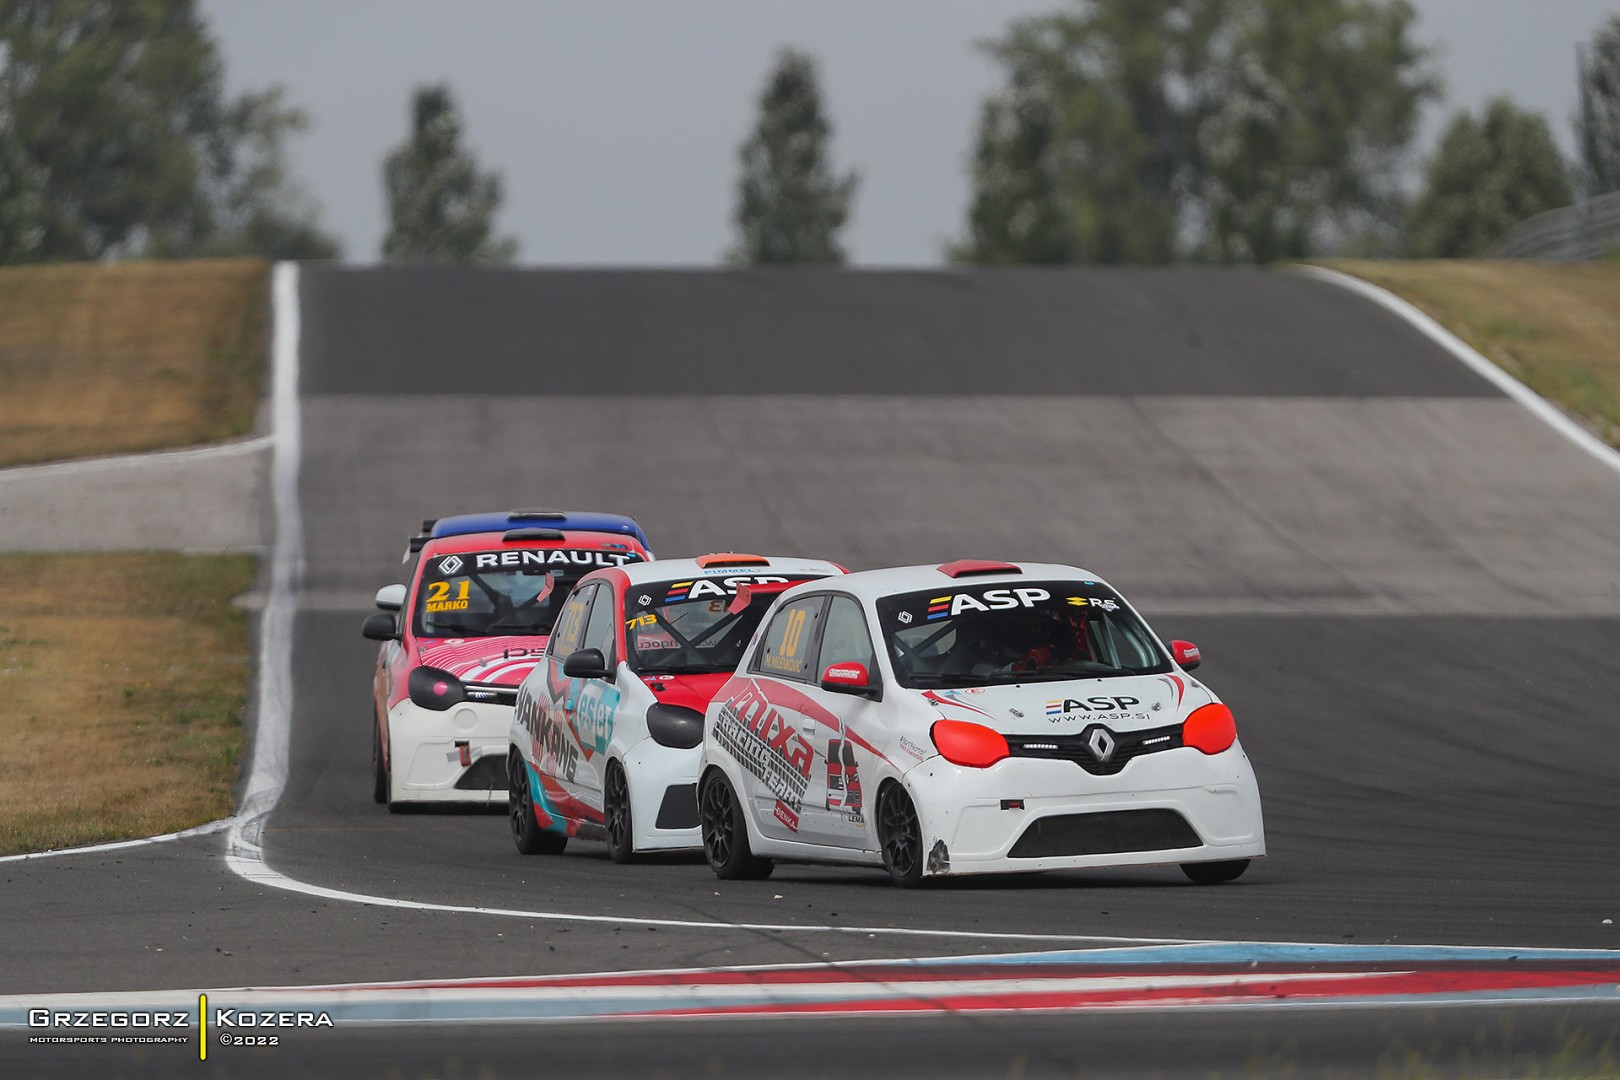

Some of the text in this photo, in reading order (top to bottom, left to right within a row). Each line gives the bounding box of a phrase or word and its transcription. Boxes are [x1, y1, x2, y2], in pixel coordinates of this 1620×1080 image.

[476, 550, 630, 569] RENAULT
[426, 580, 470, 602] 21
[425, 600, 468, 613] MARKO
[951, 588, 1051, 616] ASP
[625, 613, 657, 630] 713
[779, 608, 806, 657] 10
[1063, 696, 1140, 713] ASP
